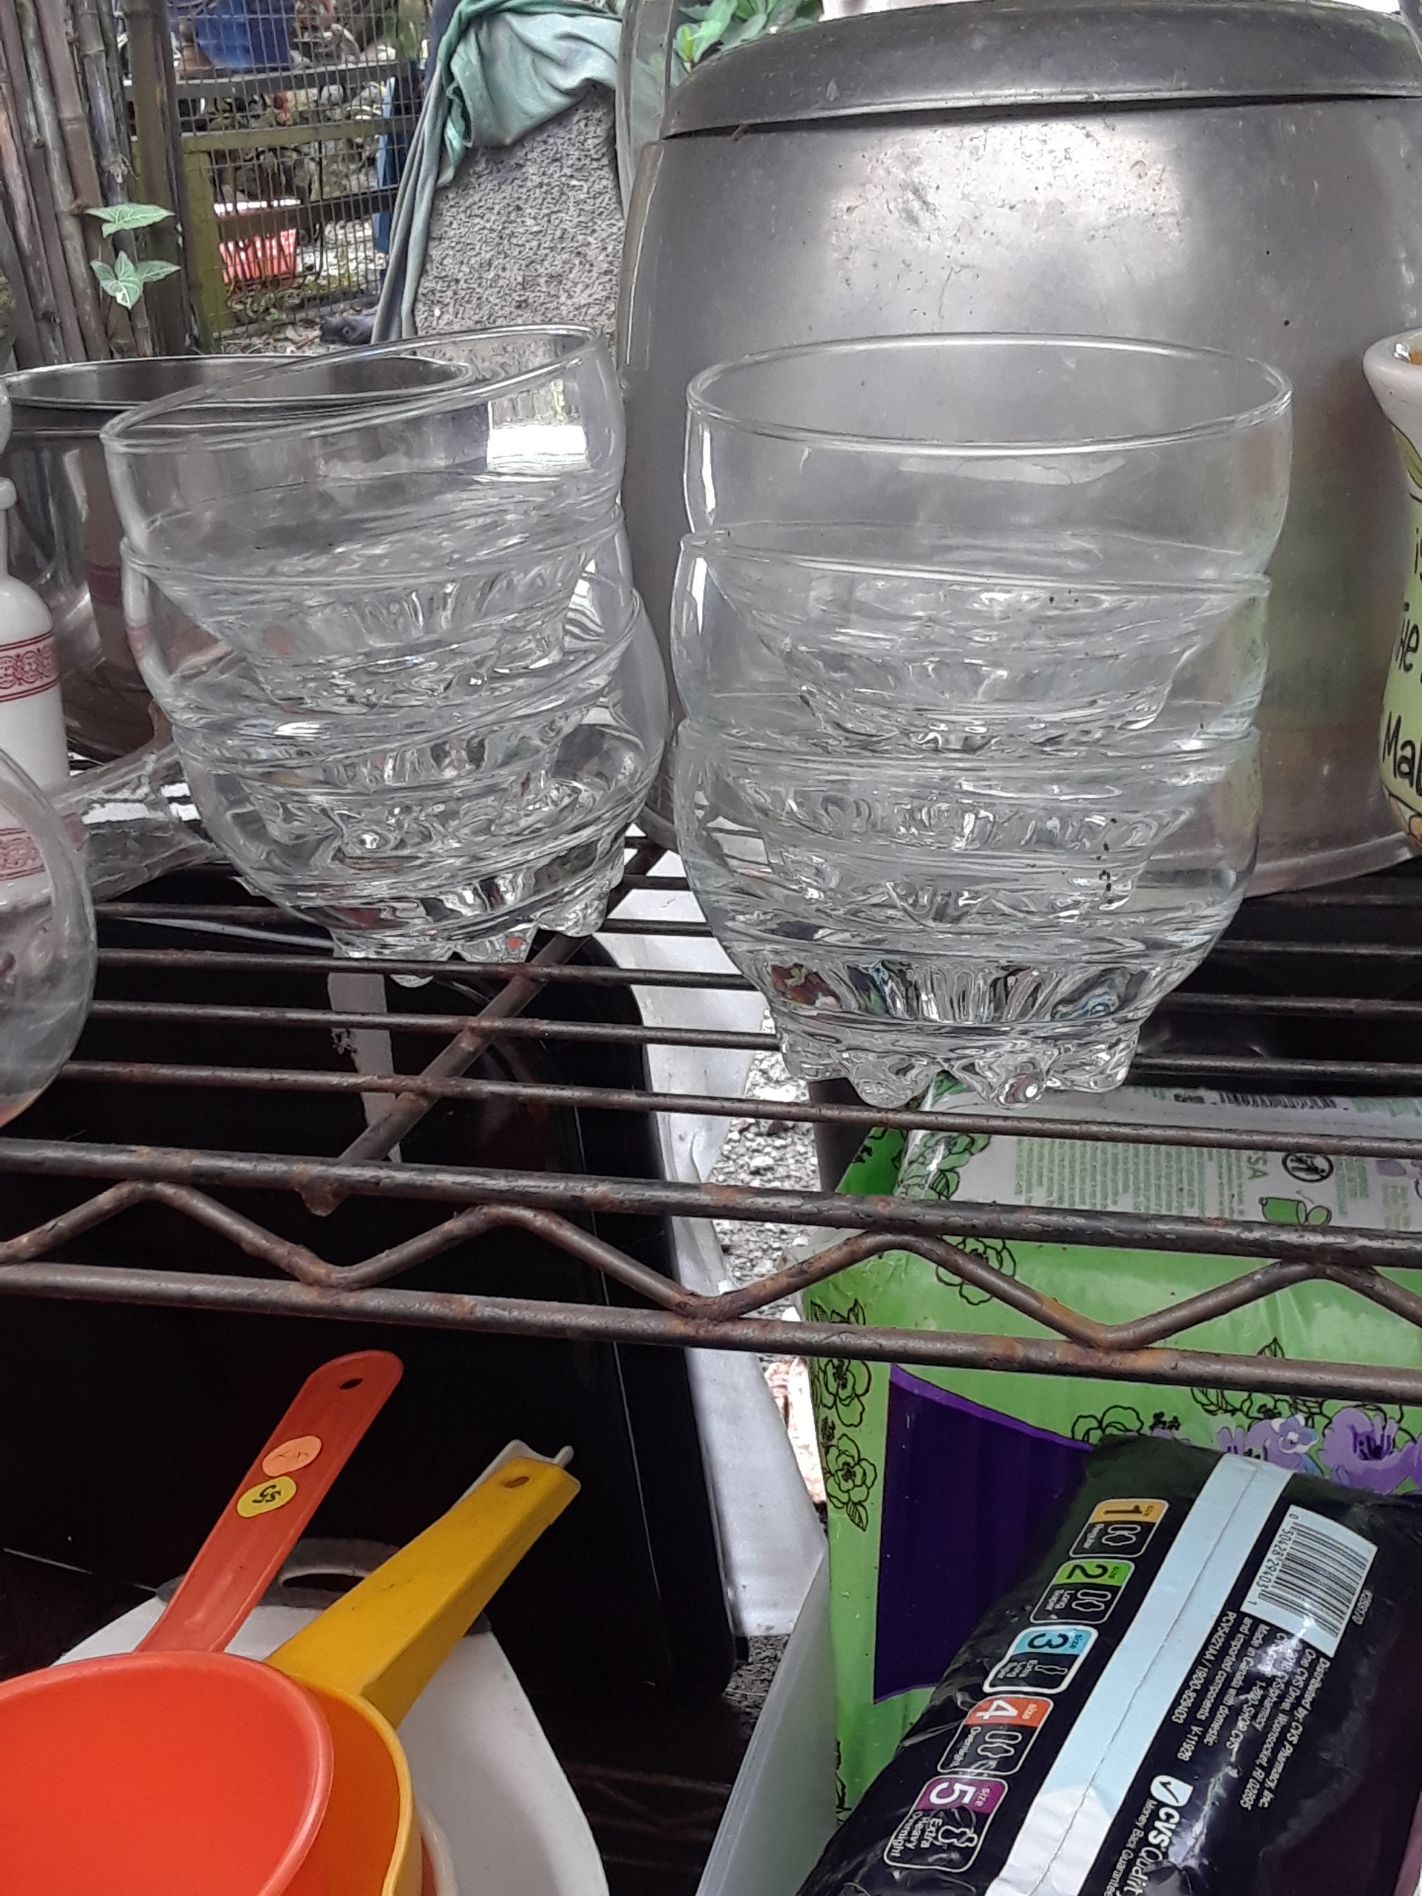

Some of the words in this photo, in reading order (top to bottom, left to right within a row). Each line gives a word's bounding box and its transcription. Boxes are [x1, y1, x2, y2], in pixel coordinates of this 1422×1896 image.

[1103, 1504, 1142, 1515] 1
[1272, 1528, 1294, 1557] 50428
[1066, 1564, 1108, 1580] 2
[1256, 1558, 1280, 1589] 29403
[1240, 1617, 1254, 1635] and
[1251, 1623, 1269, 1648] Made
[1027, 1633, 1070, 1649] 3
[1220, 1633, 1247, 1672] imported
[1247, 1647, 1258, 1657] in
[1301, 1648, 1317, 1668] One
[1231, 1656, 1254, 1689] Canada
[1293, 1667, 1309, 1689] CVS
[1301, 1657, 1330, 1708] Distributed
[1197, 1670, 1227, 1720] components
[1223, 1688, 1239, 1709] with
[976, 1700, 1018, 1719] 4
[1204, 1706, 1229, 1746] domestic
[1286, 1721, 1303, 1743] CVS
[1177, 1724, 1200, 1761] V-11928
[1252, 1767, 1265, 1780] RI
[1264, 1742, 1294, 1790] Pharmacy,
[929, 1781, 976, 1805] 5
[974, 1787, 991, 1807] size
[1258, 1790, 1273, 1809] Inc.
[1135, 1798, 1158, 1829] Money
[904, 1816, 932, 1850] Heavy
[920, 1817, 943, 1849] Extra
[1125, 1828, 1145, 1849] Back
